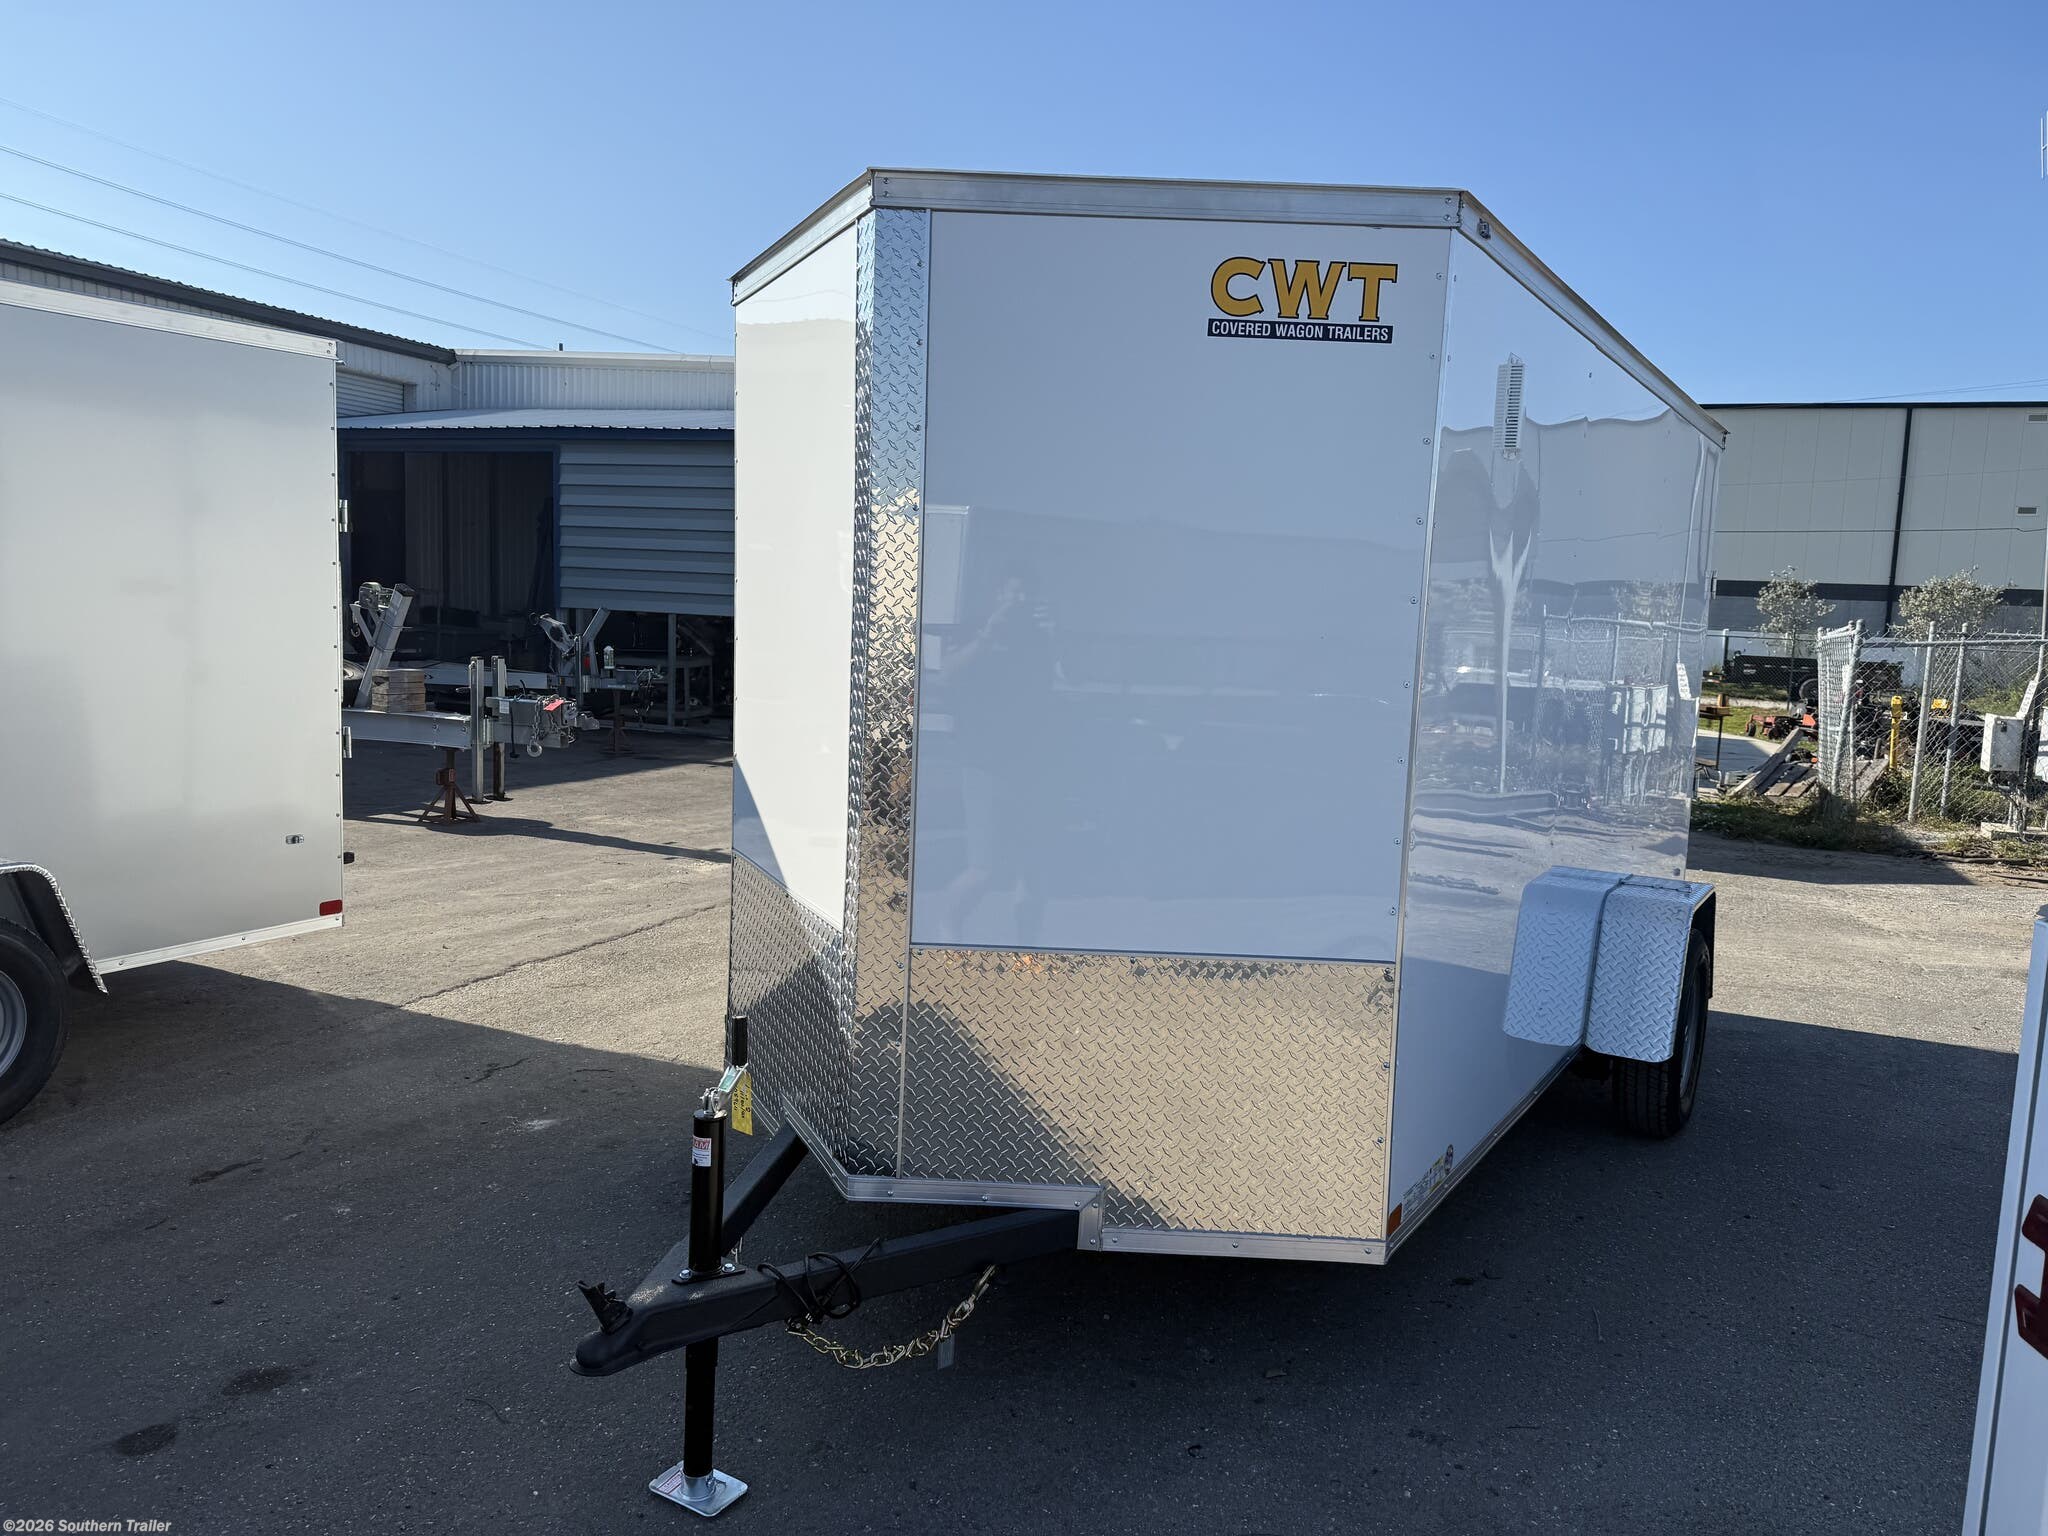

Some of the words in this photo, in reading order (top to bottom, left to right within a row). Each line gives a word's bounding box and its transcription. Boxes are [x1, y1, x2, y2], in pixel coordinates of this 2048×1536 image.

[1211, 256, 1398, 322] CWT
[1211, 321, 1271, 336] COVERED
[1275, 324, 1323, 338] WAGON
[1328, 326, 1389, 341] TRAILERS
